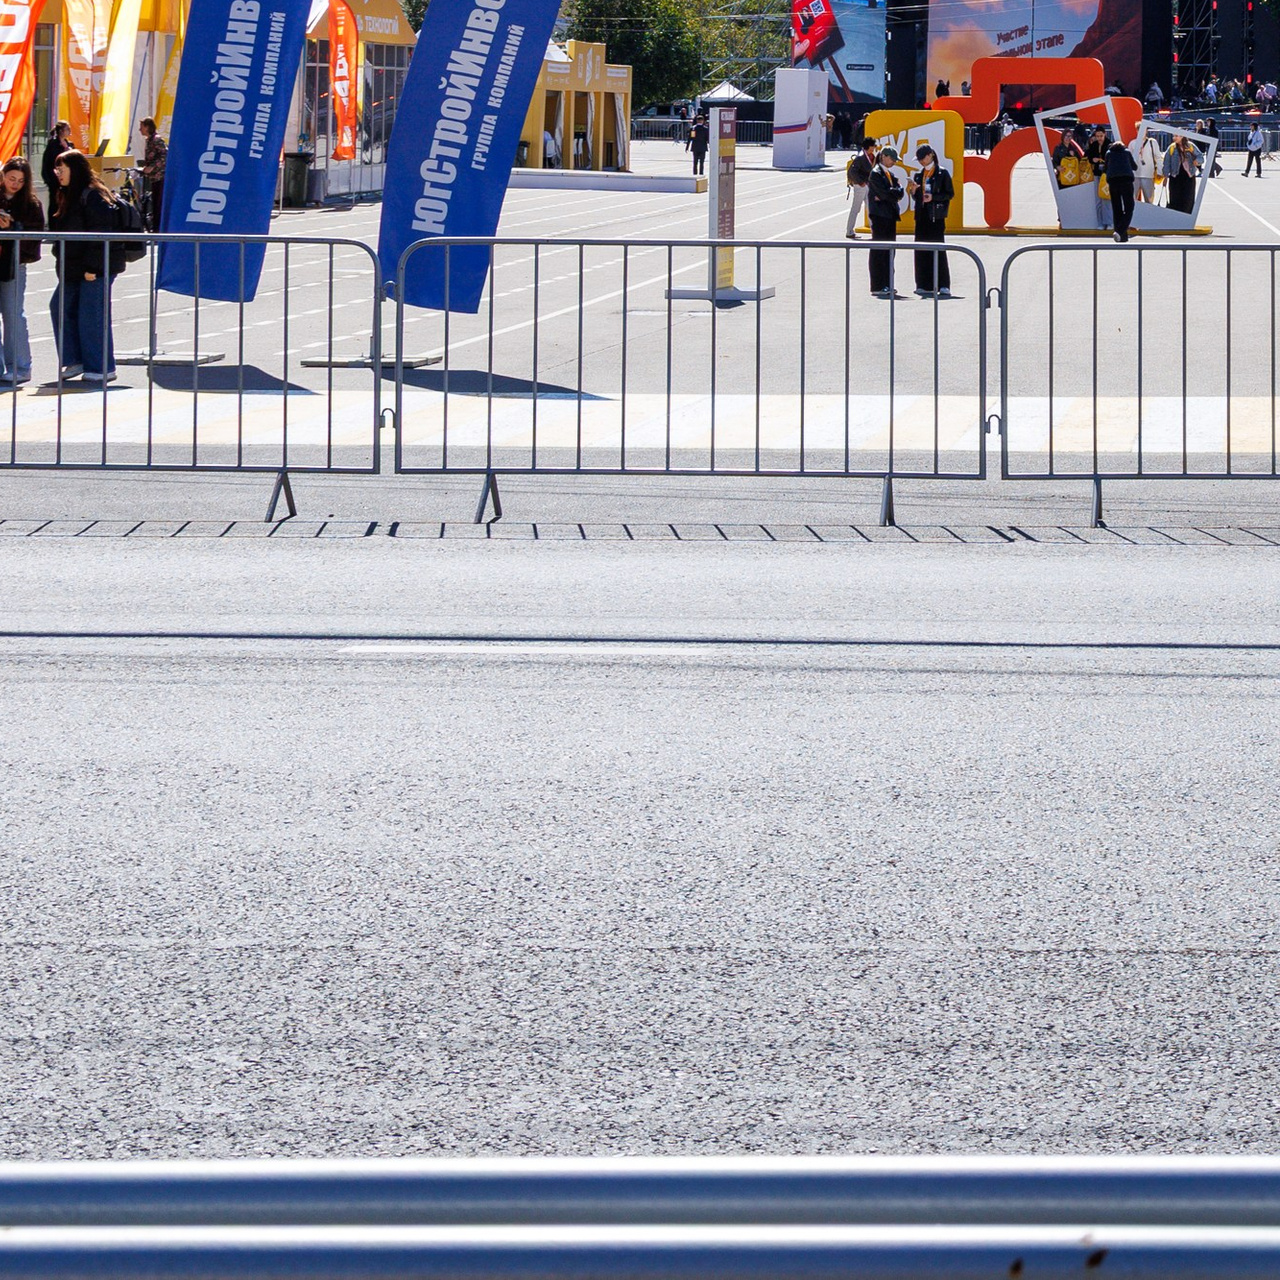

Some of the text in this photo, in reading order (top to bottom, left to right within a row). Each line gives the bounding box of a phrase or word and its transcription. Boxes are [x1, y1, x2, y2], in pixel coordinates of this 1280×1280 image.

[249, 11, 286, 159] ГРУППА КОМПАНИЙ
[471, 24, 525, 171] ГРУППА КОМПАНИЙ
